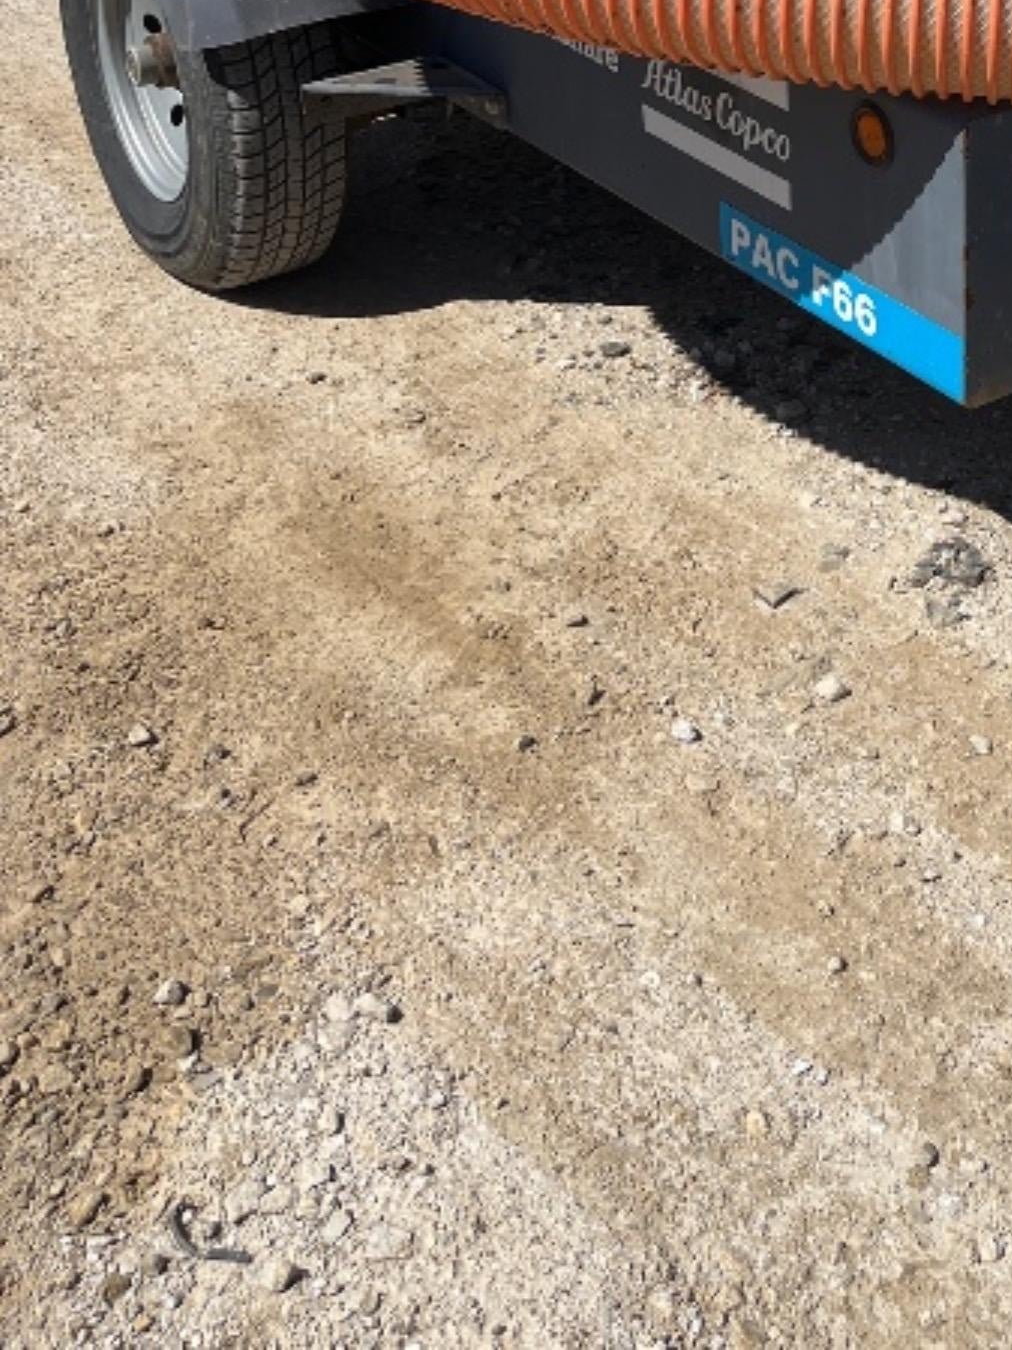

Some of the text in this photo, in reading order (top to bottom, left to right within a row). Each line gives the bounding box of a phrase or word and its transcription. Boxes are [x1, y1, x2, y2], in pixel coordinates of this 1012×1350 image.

[641, 58, 790, 160] Atlas Copco
[731, 218, 878, 337] PAC F66
